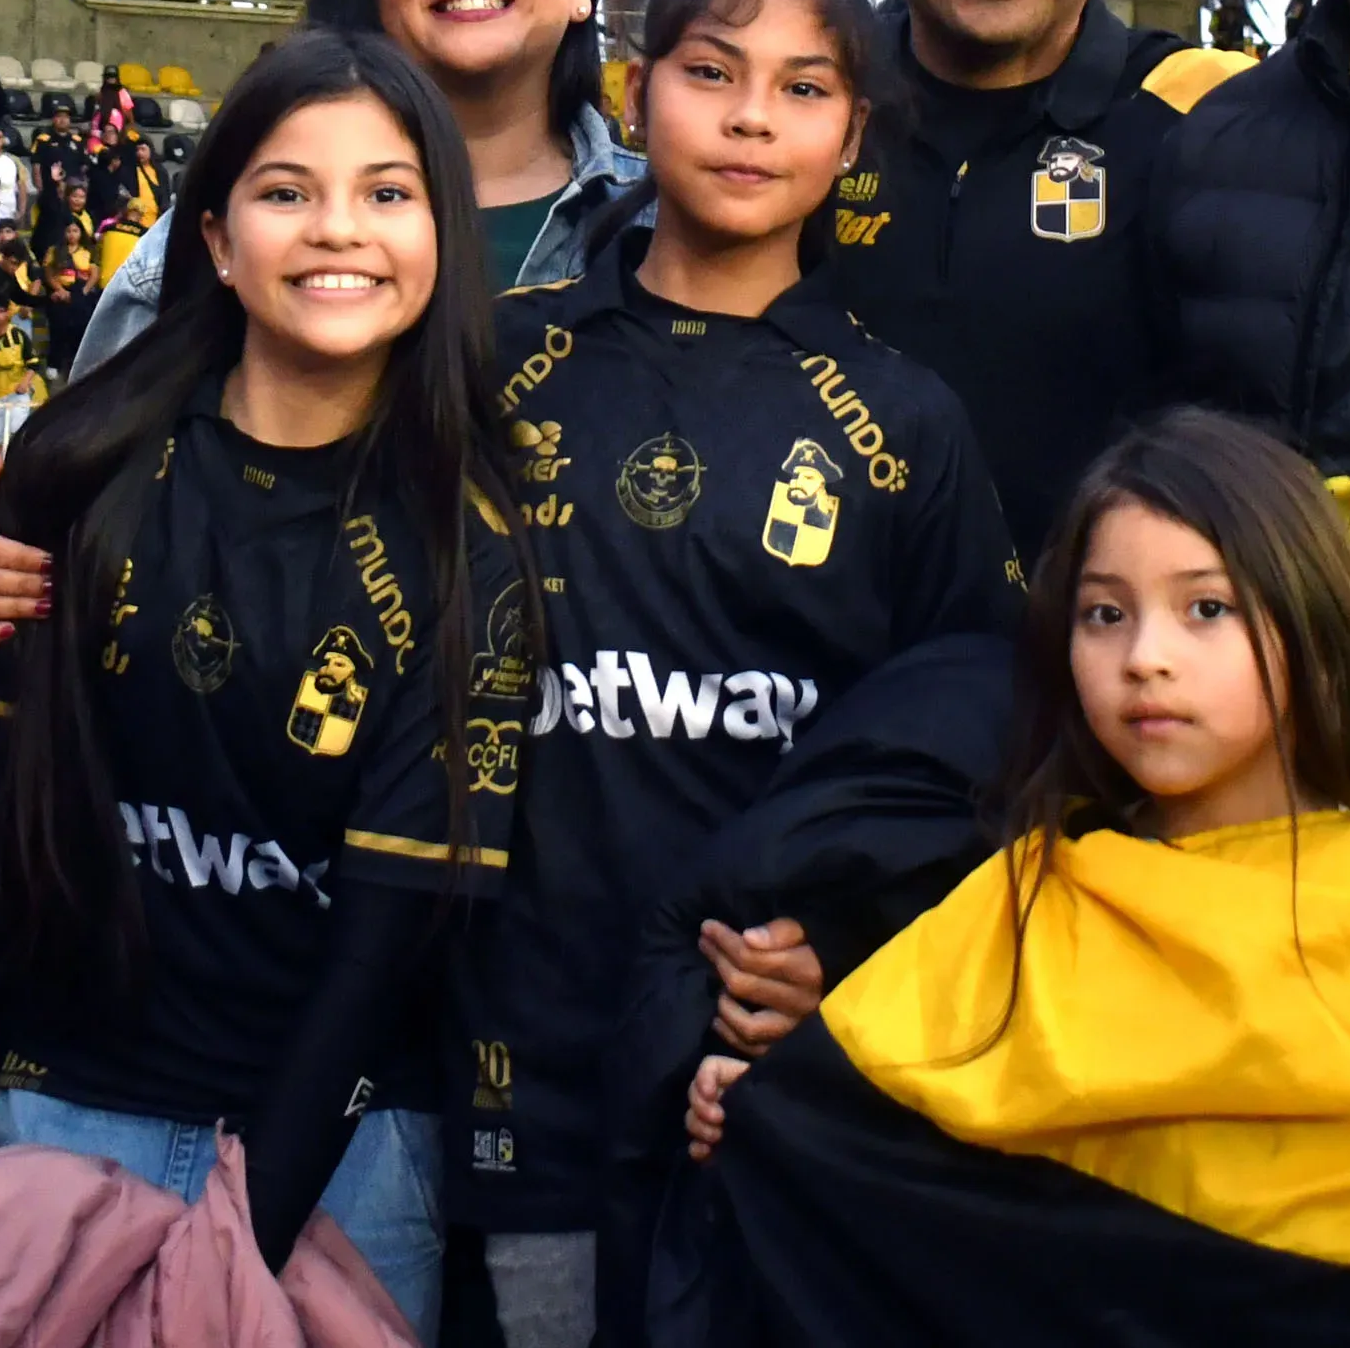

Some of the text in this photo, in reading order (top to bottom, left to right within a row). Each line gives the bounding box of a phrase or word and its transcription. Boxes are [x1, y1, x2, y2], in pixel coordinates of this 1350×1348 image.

[838, 171, 880, 194] elli
[835, 208, 891, 245] Bet
[542, 577, 566, 594] KET
